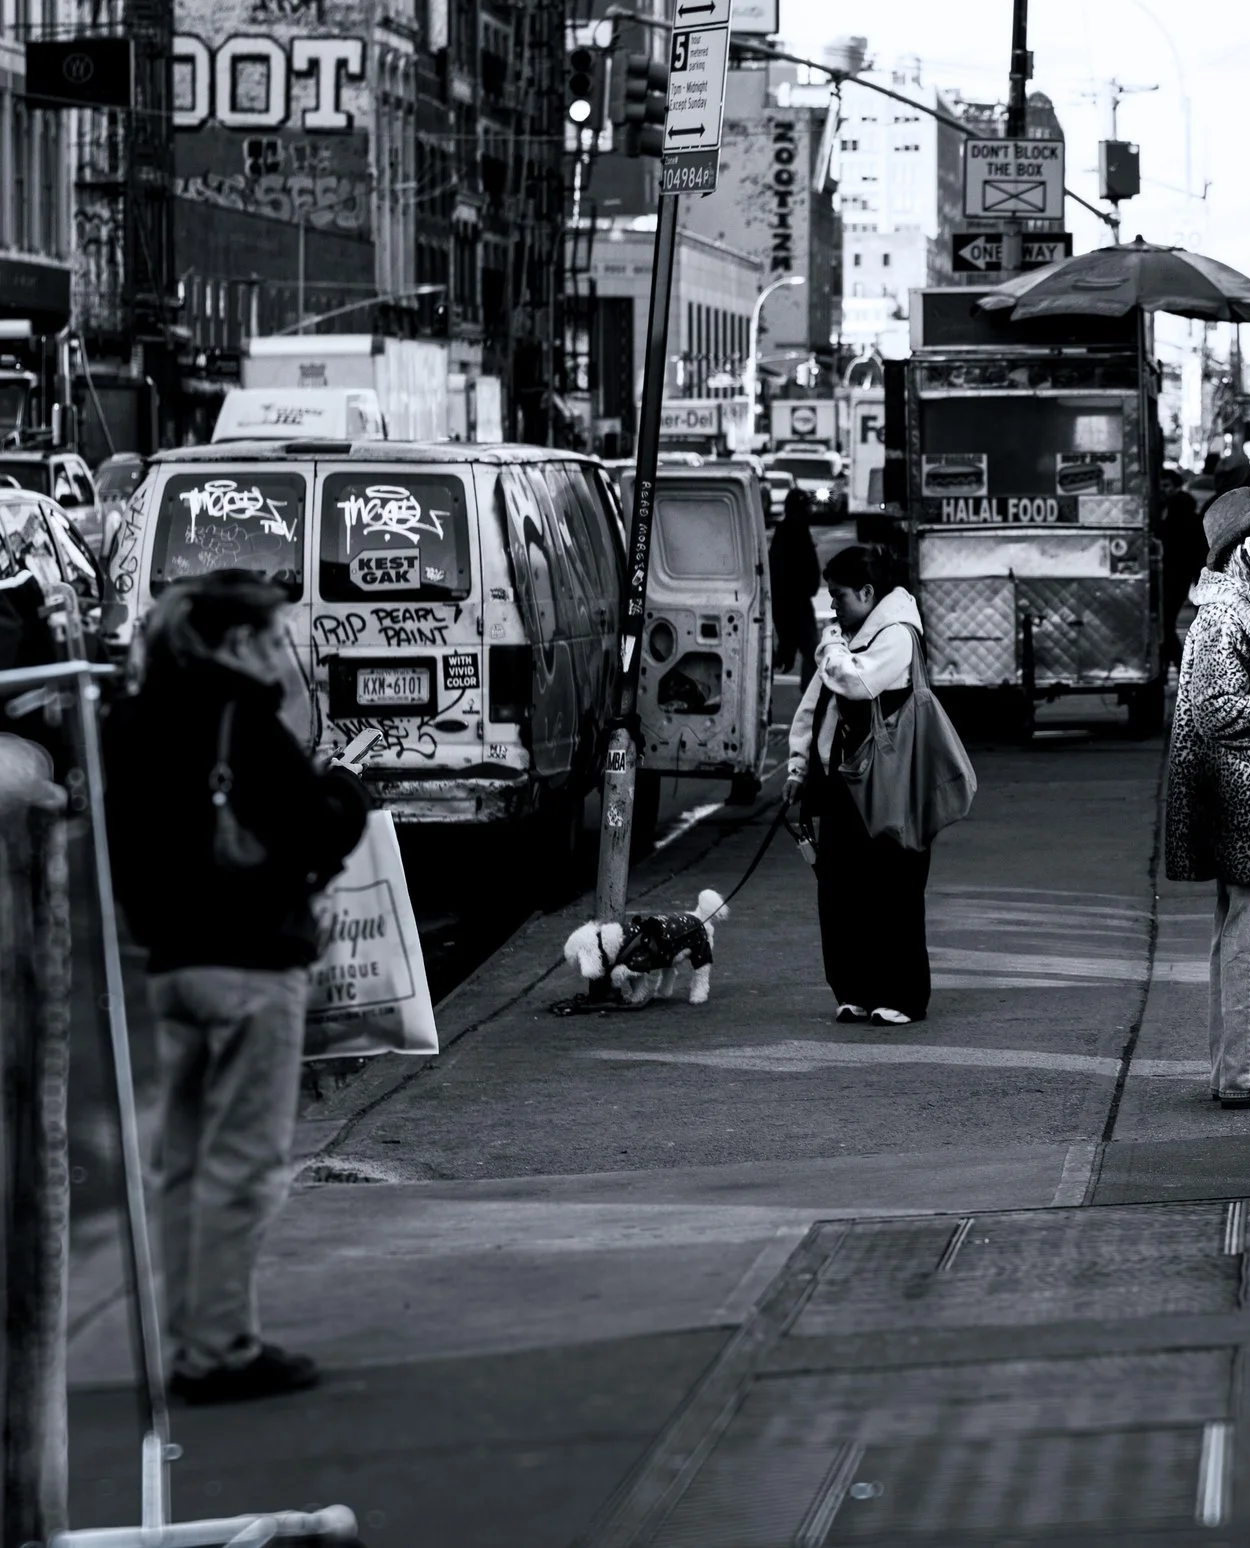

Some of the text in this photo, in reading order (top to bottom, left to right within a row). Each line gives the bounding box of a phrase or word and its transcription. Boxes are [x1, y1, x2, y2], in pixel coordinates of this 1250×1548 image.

[691, 36, 702, 45] hour
[674, 35, 686, 69] 5
[690, 47, 709, 58] metered
[688, 61, 706, 72] parking
[671, 80, 709, 95] 7pm Midnight
[669, 97, 708, 112] Except Sunday
[971, 144, 1058, 160] DON'T BLOCK
[987, 163, 1043, 177] THE BOX
[970, 244, 1058, 260] ONE WAY
[639, 481, 652, 517] READ
[942, 498, 1059, 523] HALAL FOOD
[358, 556, 418, 571] KEST
[361, 570, 410, 584] GAK
[371, 607, 446, 627] PEARL
[378, 625, 449, 647] PAINT
[449, 656, 472, 666] WITH
[449, 666, 475, 676] VIVID
[447, 677, 477, 688] COLOR
